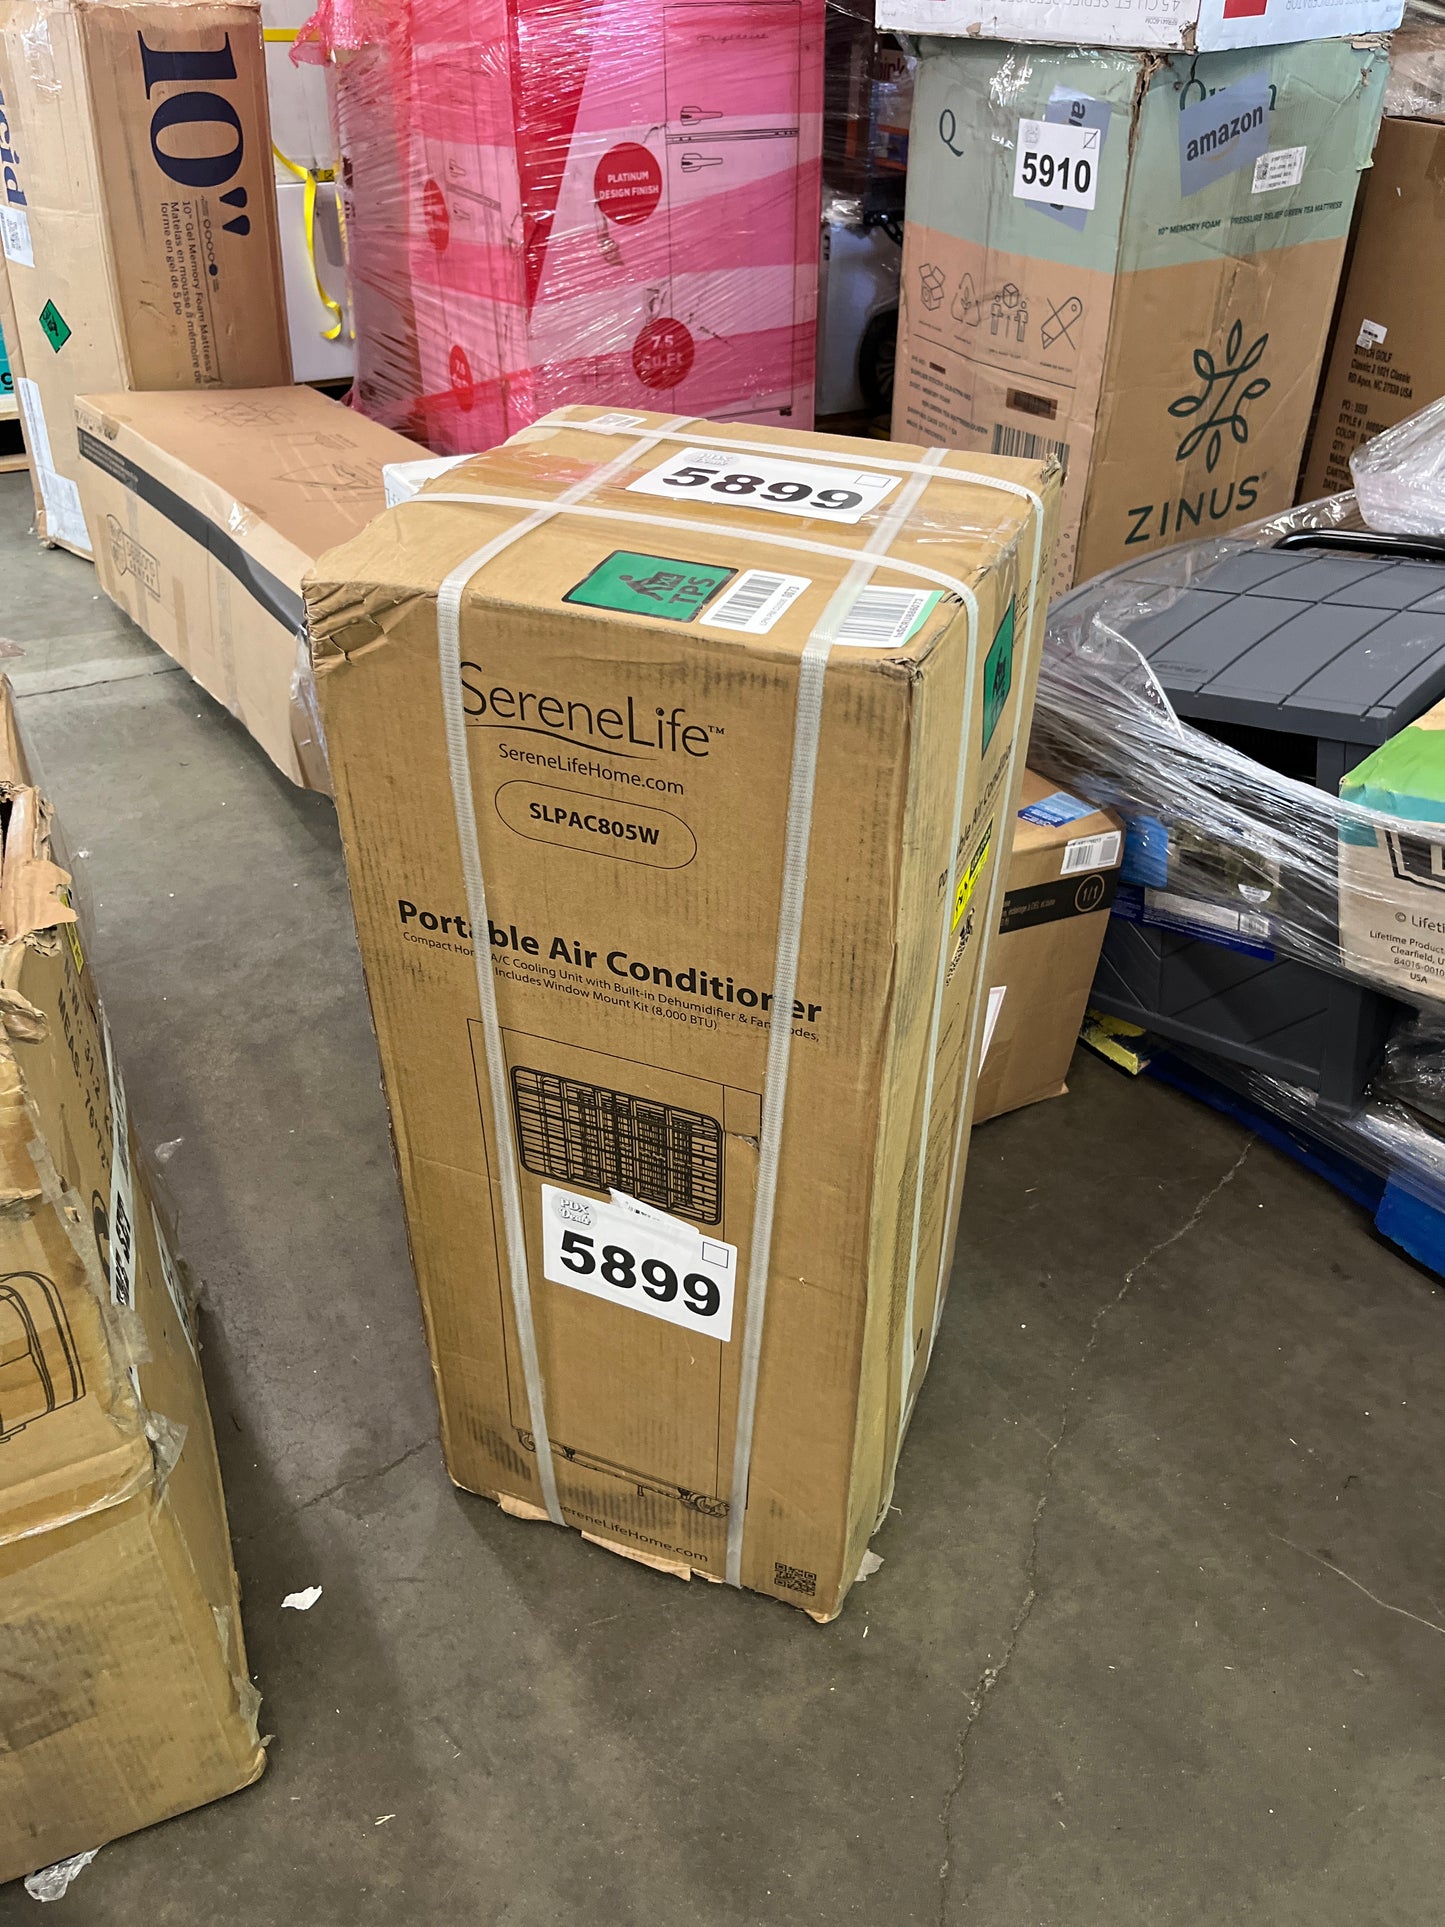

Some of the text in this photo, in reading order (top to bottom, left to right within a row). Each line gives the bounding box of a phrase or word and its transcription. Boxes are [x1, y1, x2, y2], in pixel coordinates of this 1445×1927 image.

[939, 108, 964, 157] Q
[1186, 105, 1264, 162] amazon
[607, 171, 650, 183] PLATINUM
[1022, 151, 1091, 194] 5910
[599, 184, 660, 199] DESIGN FINISH
[160, 202, 172, 237] forme
[170, 201, 184, 247] Matelas
[184, 222, 196, 243] Gel
[1170, 222, 1201, 234] MEMORY
[1201, 219, 1222, 229] FOAM
[1231, 212, 1264, 225] PRESSURE
[165, 239, 175, 253] en
[177, 248, 187, 264] en
[165, 255, 178, 273] gel
[188, 243, 203, 290] Memory
[170, 274, 181, 289] de
[179, 265, 192, 309] mousse
[171, 301, 184, 316] po
[195, 291, 207, 323] Foam
[187, 320, 202, 368] mémoire
[199, 323, 214, 372] Mattress
[1376, 349, 1393, 363] GOLF
[1351, 358, 1370, 374] Classic
[1390, 368, 1411, 384] Classic
[1399, 384, 1413, 399] USA
[662, 466, 864, 511] 5899
[1124, 475, 1260, 545] ZINUS
[499, 743, 684, 796] SereneLifeHome.com
[529, 802, 660, 846] SLPAC805W
[398, 899, 540, 957] Portble
[549, 936, 598, 969] Air
[1369, 930, 1407, 945] Lifetime
[1390, 945, 1436, 965] Clearfield,
[1393, 957, 1445, 978] 84016-0010
[402, 931, 452, 953] Compact
[491, 952, 511, 967] A/C
[512, 956, 556, 980] Cooling
[558, 966, 583, 984] Unit
[586, 972, 612, 991] with
[614, 978, 656, 1003] Built-in
[657, 988, 736, 1020] Dehumidifier
[738, 1010, 748, 1024] &
[790, 1026, 820, 1043] odes,
[1409, 972, 1429, 984] USA
[495, 966, 718, 1031] Includes Window Mount Kit (8,000 BTU)
[559, 1228, 721, 1319] 5899
